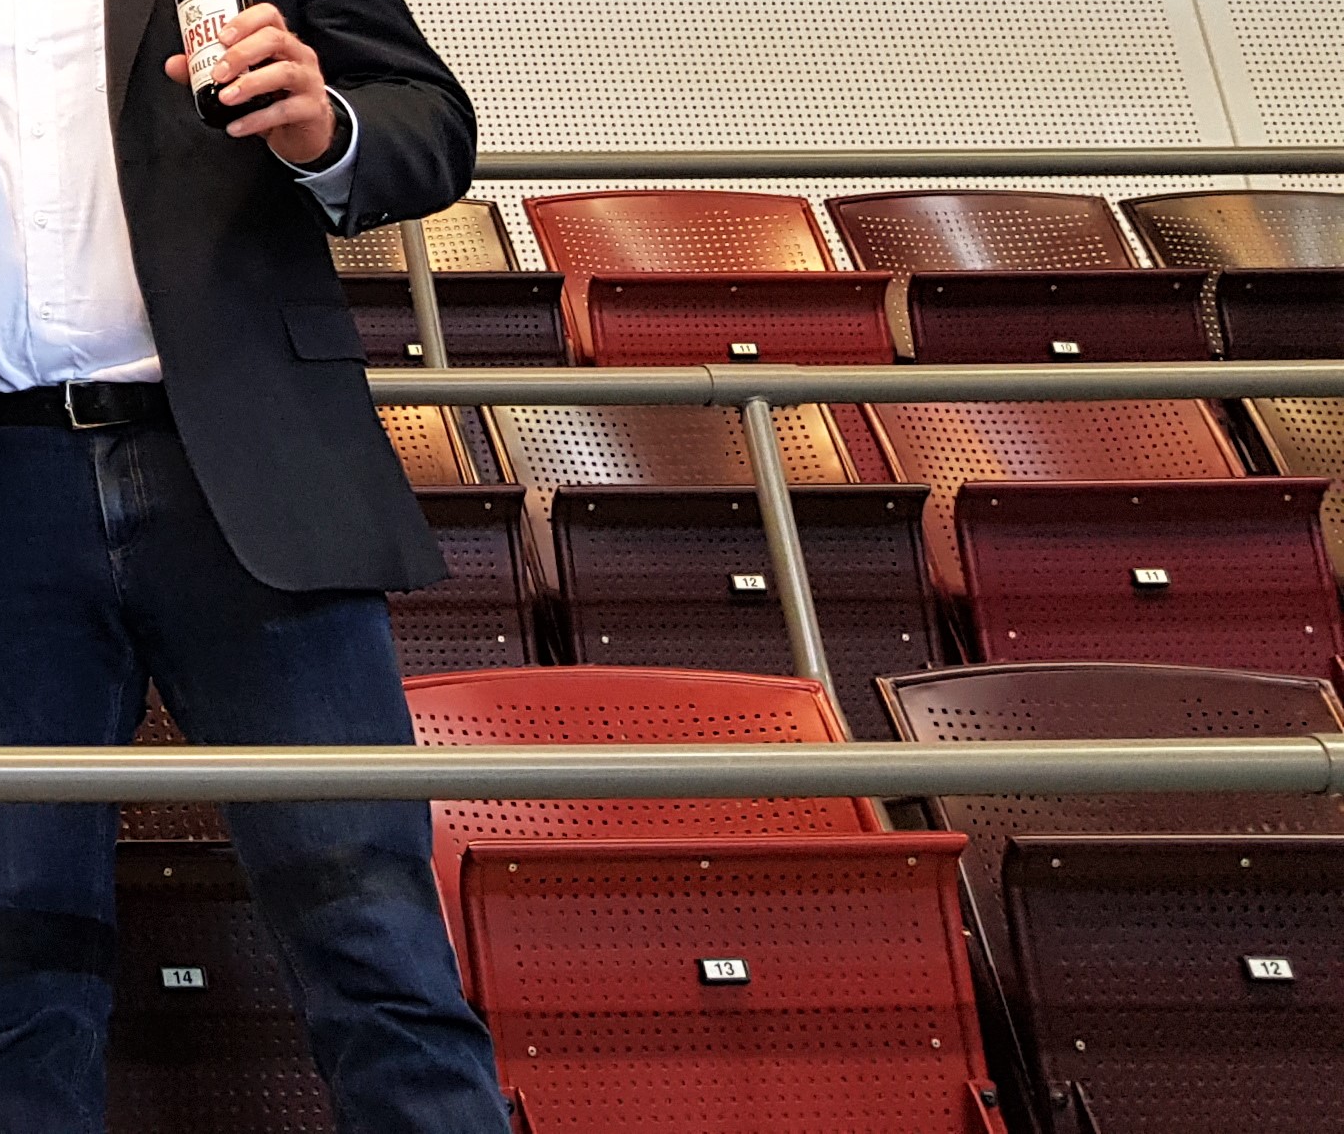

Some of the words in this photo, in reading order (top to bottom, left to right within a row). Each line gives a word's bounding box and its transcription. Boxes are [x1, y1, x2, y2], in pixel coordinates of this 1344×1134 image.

[742, 577, 758, 588] 12
[1144, 571, 1160, 581] 11
[715, 961, 735, 976] 13
[1260, 961, 1283, 975] 12
[173, 970, 193, 985] 14
